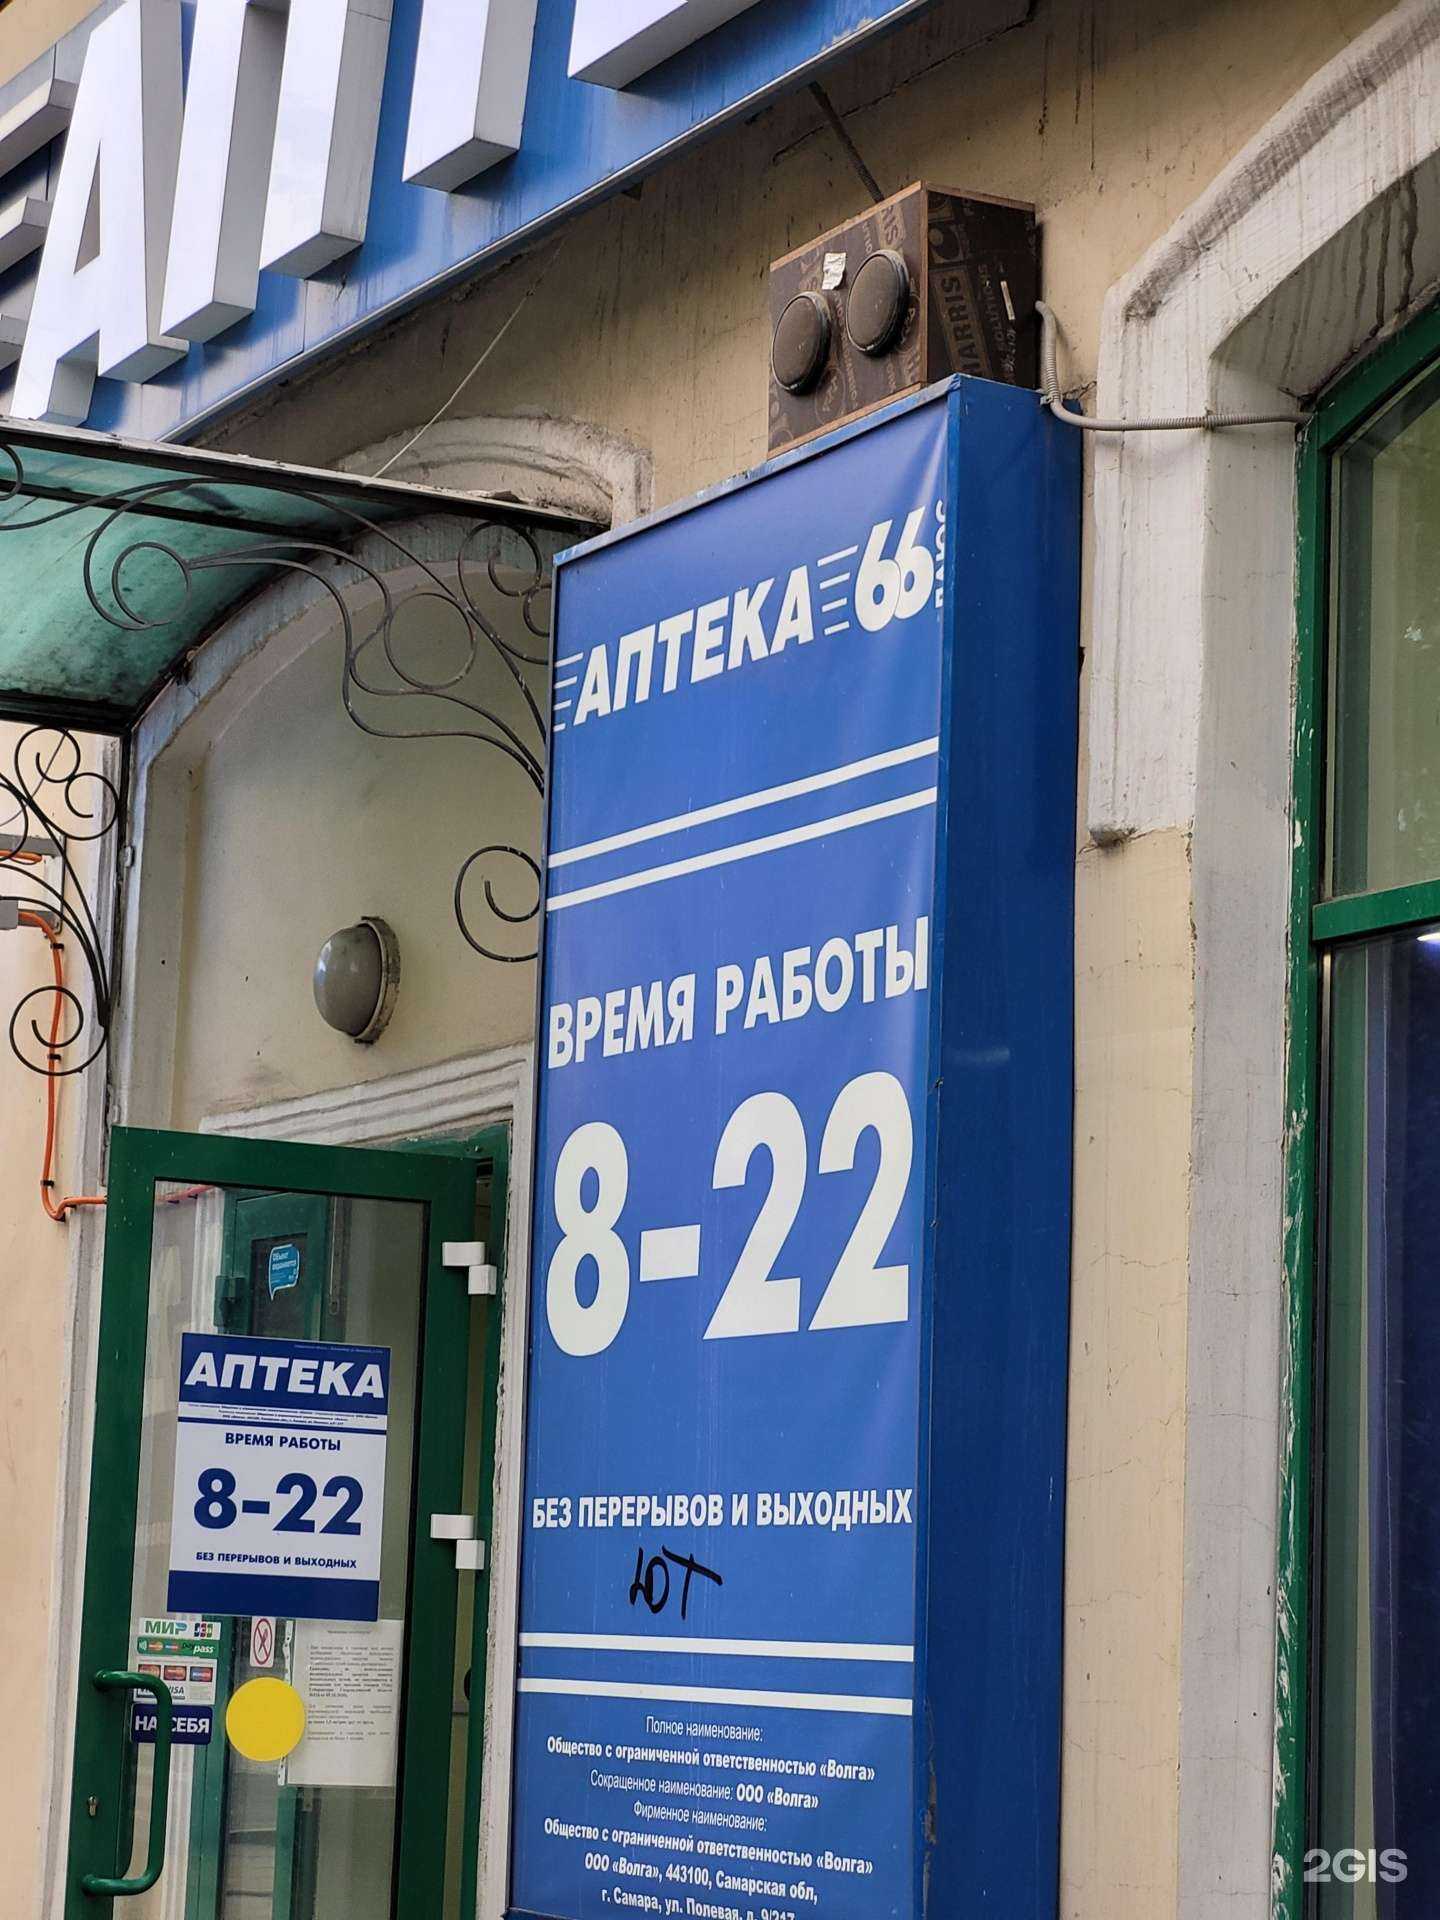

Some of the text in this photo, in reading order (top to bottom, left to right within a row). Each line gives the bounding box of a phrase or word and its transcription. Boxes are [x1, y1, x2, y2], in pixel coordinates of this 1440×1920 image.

[573, 506, 934, 727] АПТЕКА 66
[548, 916, 929, 1069] ВРЕМЯ РАБОТЫ
[546, 1071, 913, 1356] 8-22
[184, 1352, 385, 1399] АПТЕКА
[225, 1432, 341, 1451] ВРЕМЯ РАБОТЫ
[193, 1467, 364, 1536] 8-22
[532, 1489, 912, 1531] БЕЗ ПЕРЕРЫВОВ И ВЫХОДНЫХ
[195, 1551, 357, 1569] БЕЗ ПЕРЕРЫВОВ И ВЫХОДНЫХ
[145, 1620, 187, 1635] МИР
[646, 1715, 763, 1742] Полное наименование:
[547, 1736, 875, 1781] Общество с ограниченной ответственностью «Волга»
[590, 1769, 819, 1809] Сокращенное наименование: ООО «Волга»
[634, 1800, 768, 1832] Фирменное наименование:
[544, 1817, 873, 1875] Общество с ограниченной ответственностью «Волга»
[585, 1852, 610, 1872] ООО
[612, 1856, 663, 1883] «Волга»,
[665, 1863, 712, 1890] 443100,
[716, 1869, 786, 1897] Самарская
[602, 1888, 611, 1902] г.
[613, 1886, 662, 1913] Самара,
[665, 1898, 683, 1916] ул.
